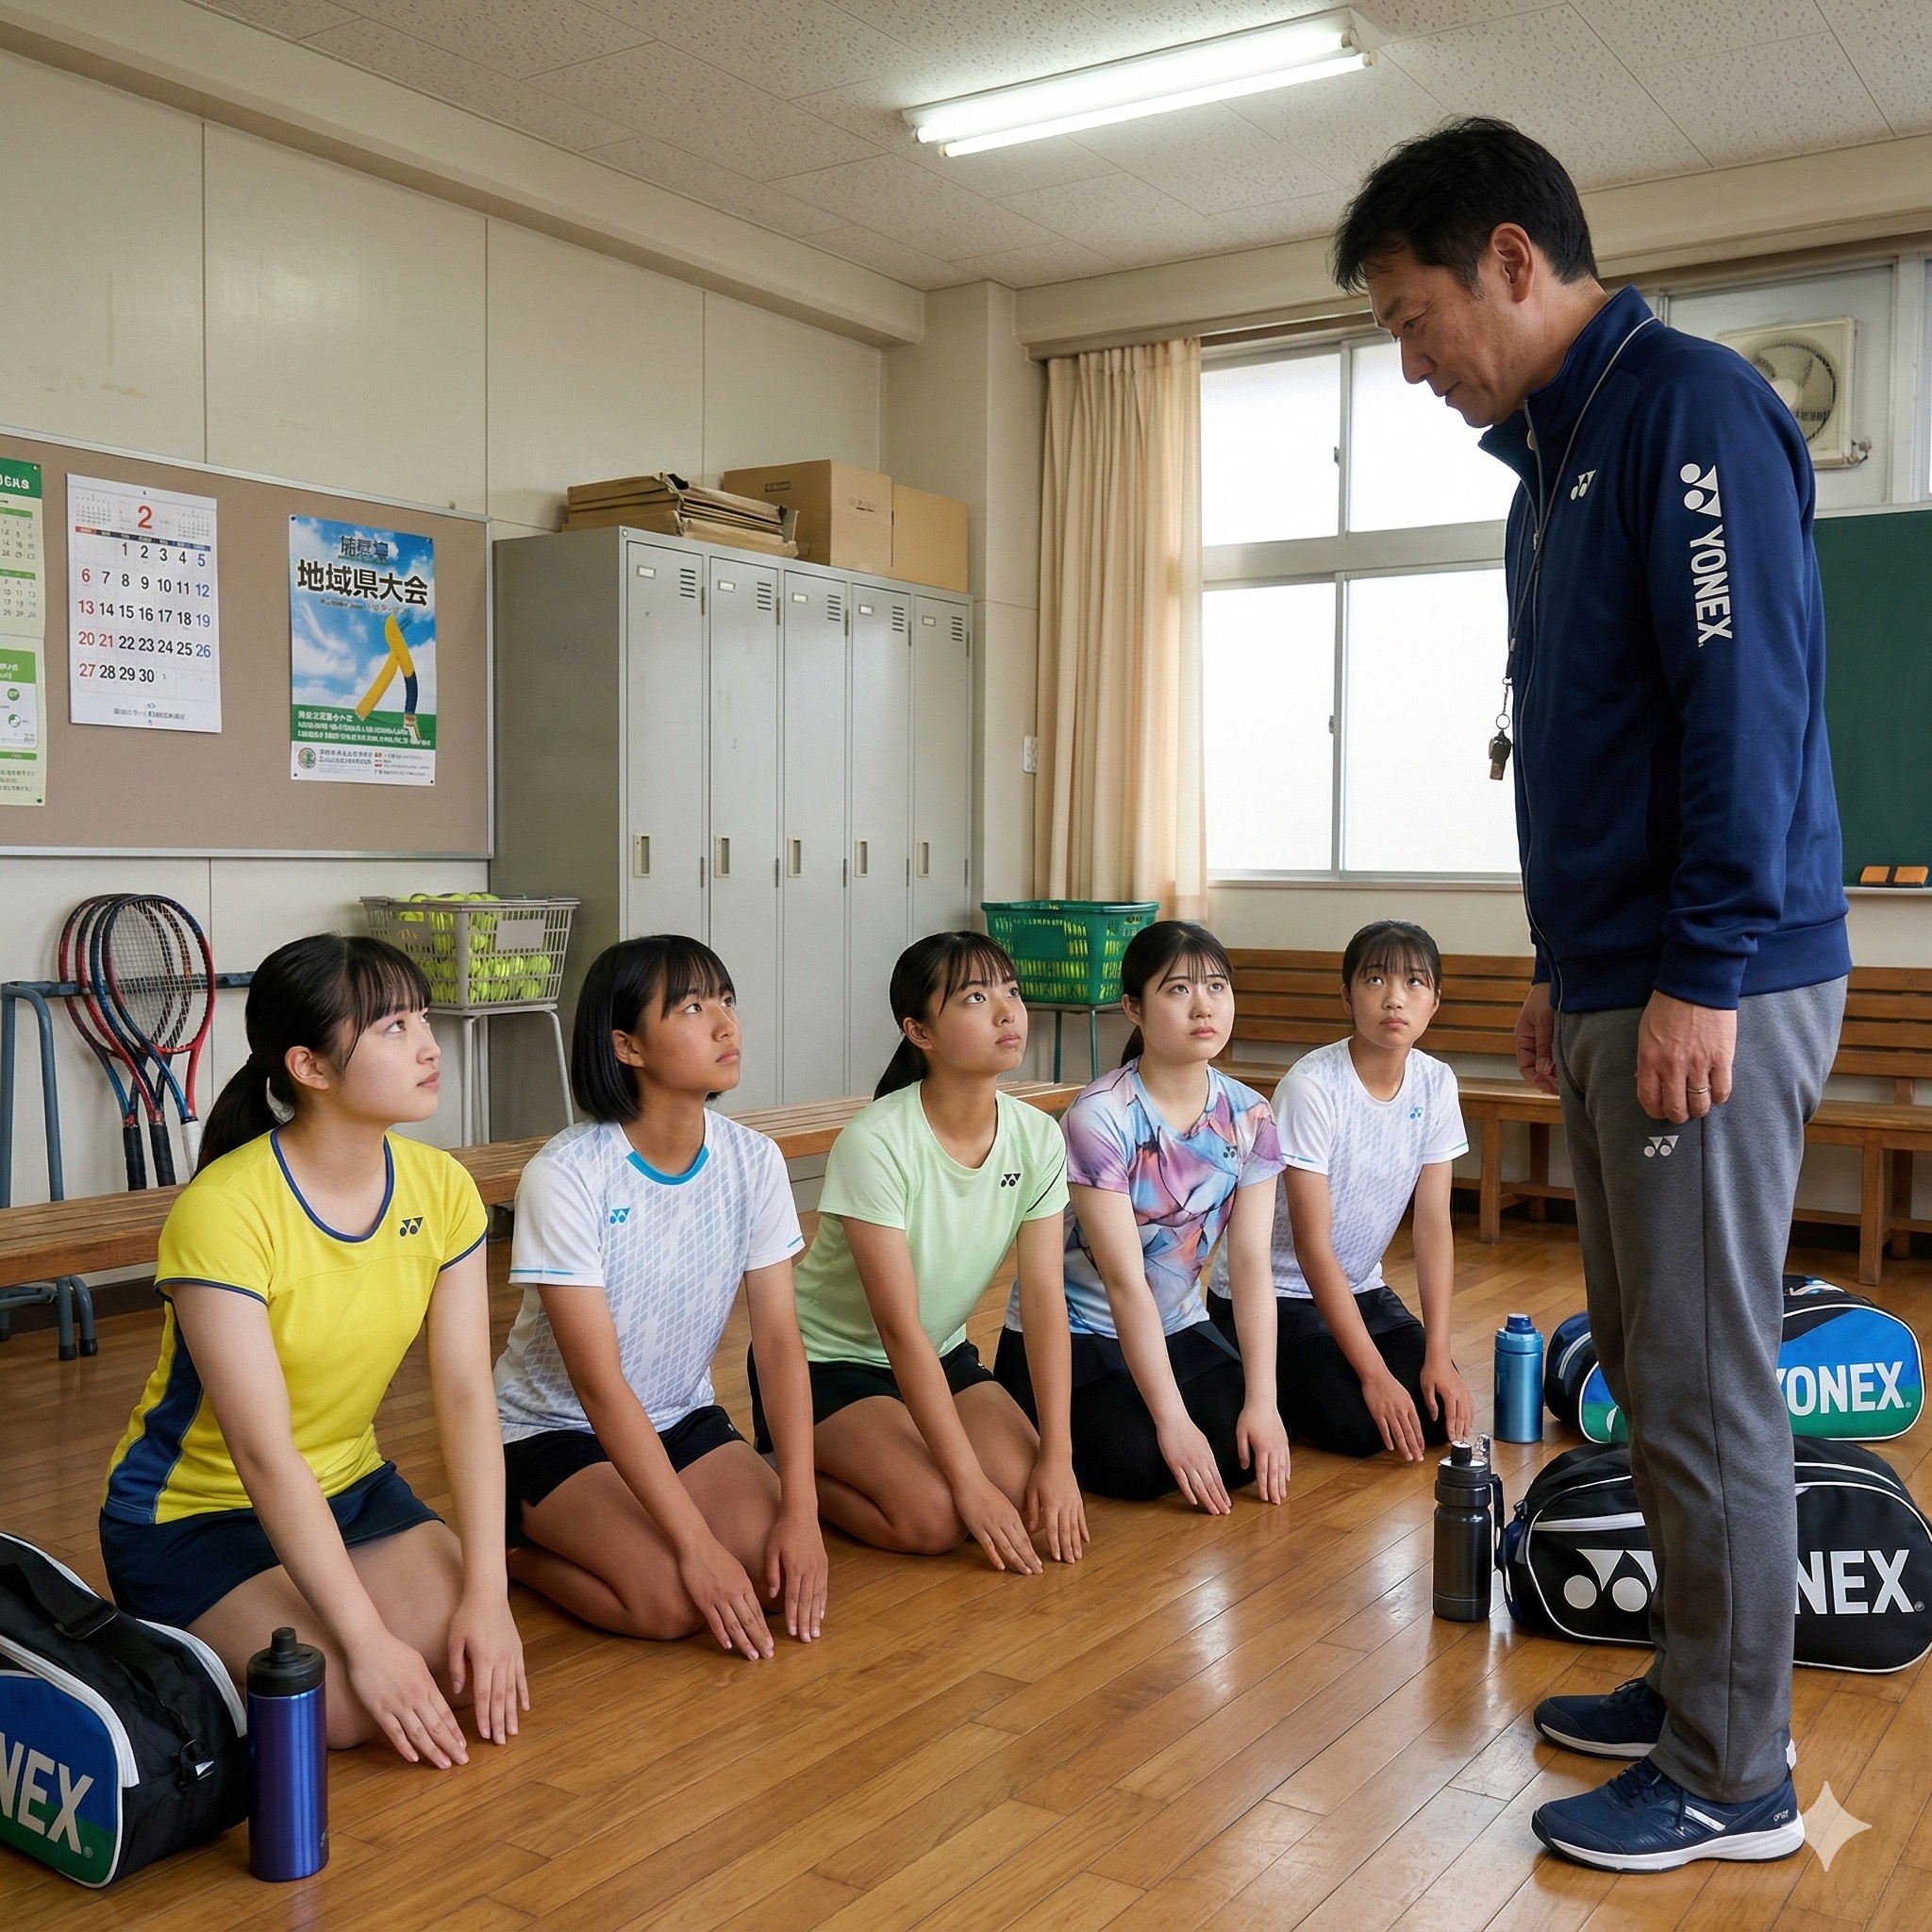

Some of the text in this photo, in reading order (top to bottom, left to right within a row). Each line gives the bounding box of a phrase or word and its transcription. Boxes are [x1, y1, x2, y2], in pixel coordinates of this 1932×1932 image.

[138, 506, 152, 529] 2
[123, 542, 205, 567] 1 2 3 4 5
[82, 569, 209, 597] 6 7 8 9 10 11 12
[297, 558, 428, 607] 地域県大会
[1690, 525, 1732, 644] YONEX
[78, 600, 209, 627] 13 14 15 16 17 18 19
[79, 631, 210, 658] 20 21 22 23 24 25 26
[79, 663, 95, 676] 27
[100, 665, 115, 679] 28
[120, 667, 135, 680] 29
[140, 669, 154, 682] 30
